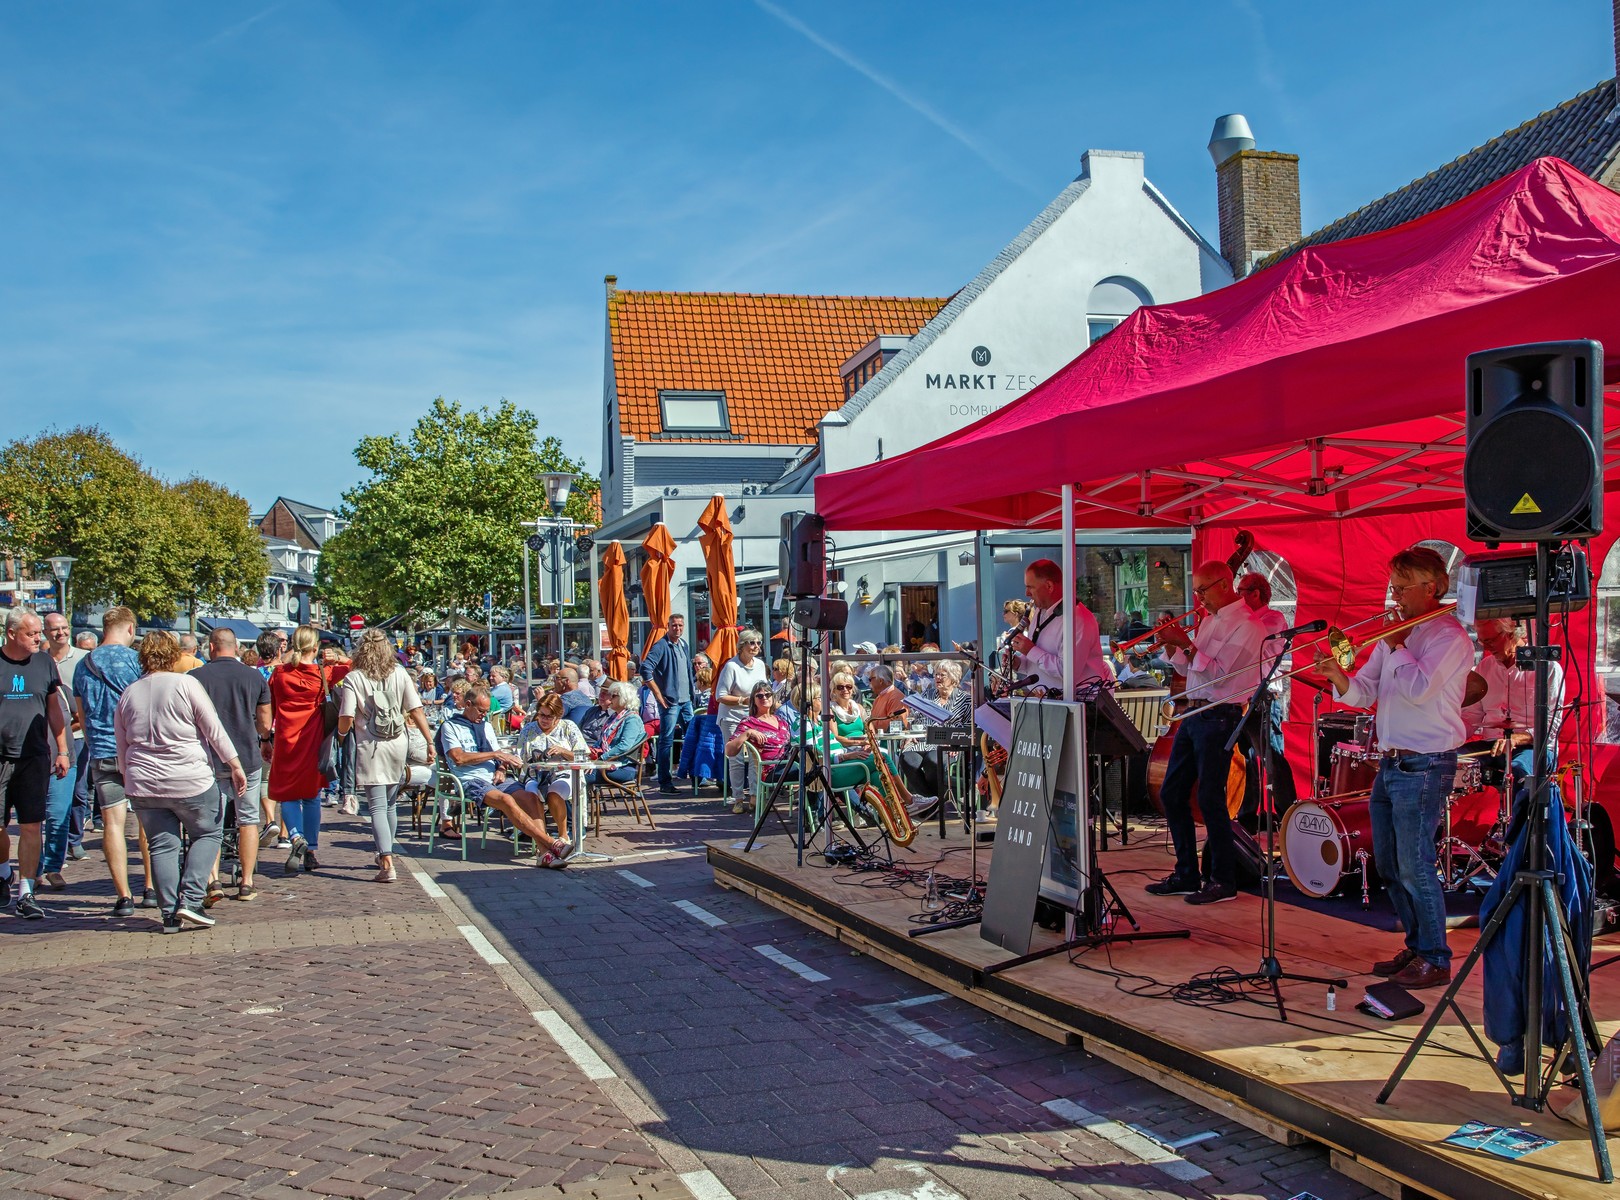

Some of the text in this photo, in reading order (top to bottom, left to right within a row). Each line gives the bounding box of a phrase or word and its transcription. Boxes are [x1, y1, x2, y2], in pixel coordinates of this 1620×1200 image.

[926, 373, 1037, 391] MARKT ZES
[1017, 740, 1052, 760] CHARLES
[1017, 771, 1042, 790] TOWN
[1012, 799, 1037, 818] JAZZ
